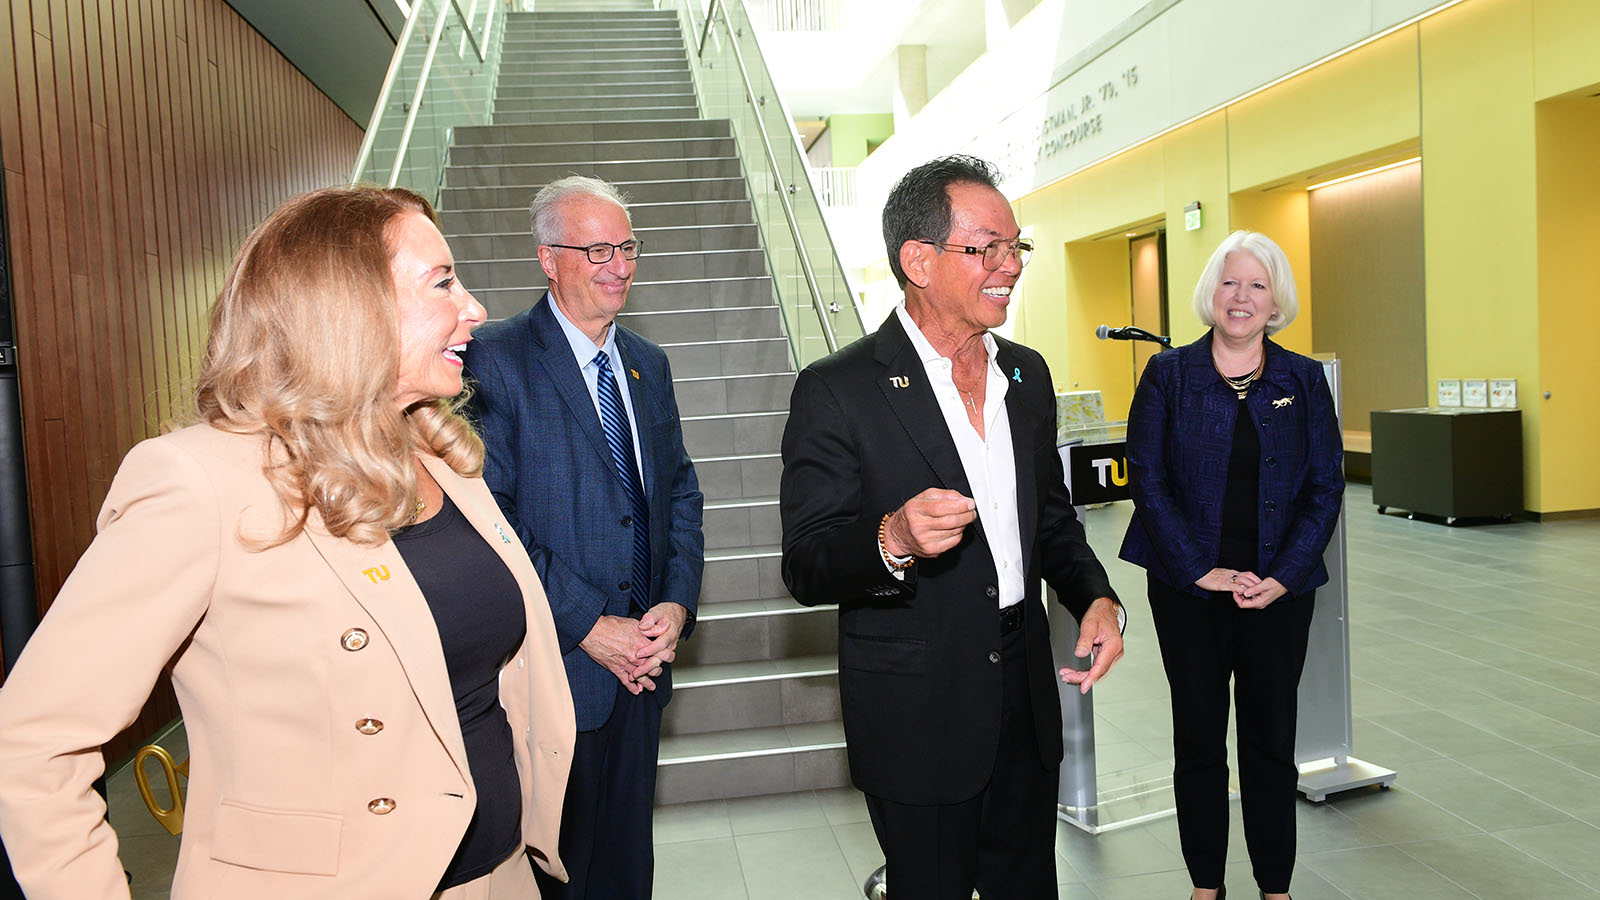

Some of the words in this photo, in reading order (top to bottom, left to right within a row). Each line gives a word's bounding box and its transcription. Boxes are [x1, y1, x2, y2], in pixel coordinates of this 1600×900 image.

[1045, 113, 1103, 158] CONCOURSE
[889, 375, 910, 389] TU
[1092, 457, 1129, 488] TU
[361, 564, 391, 584] TU
